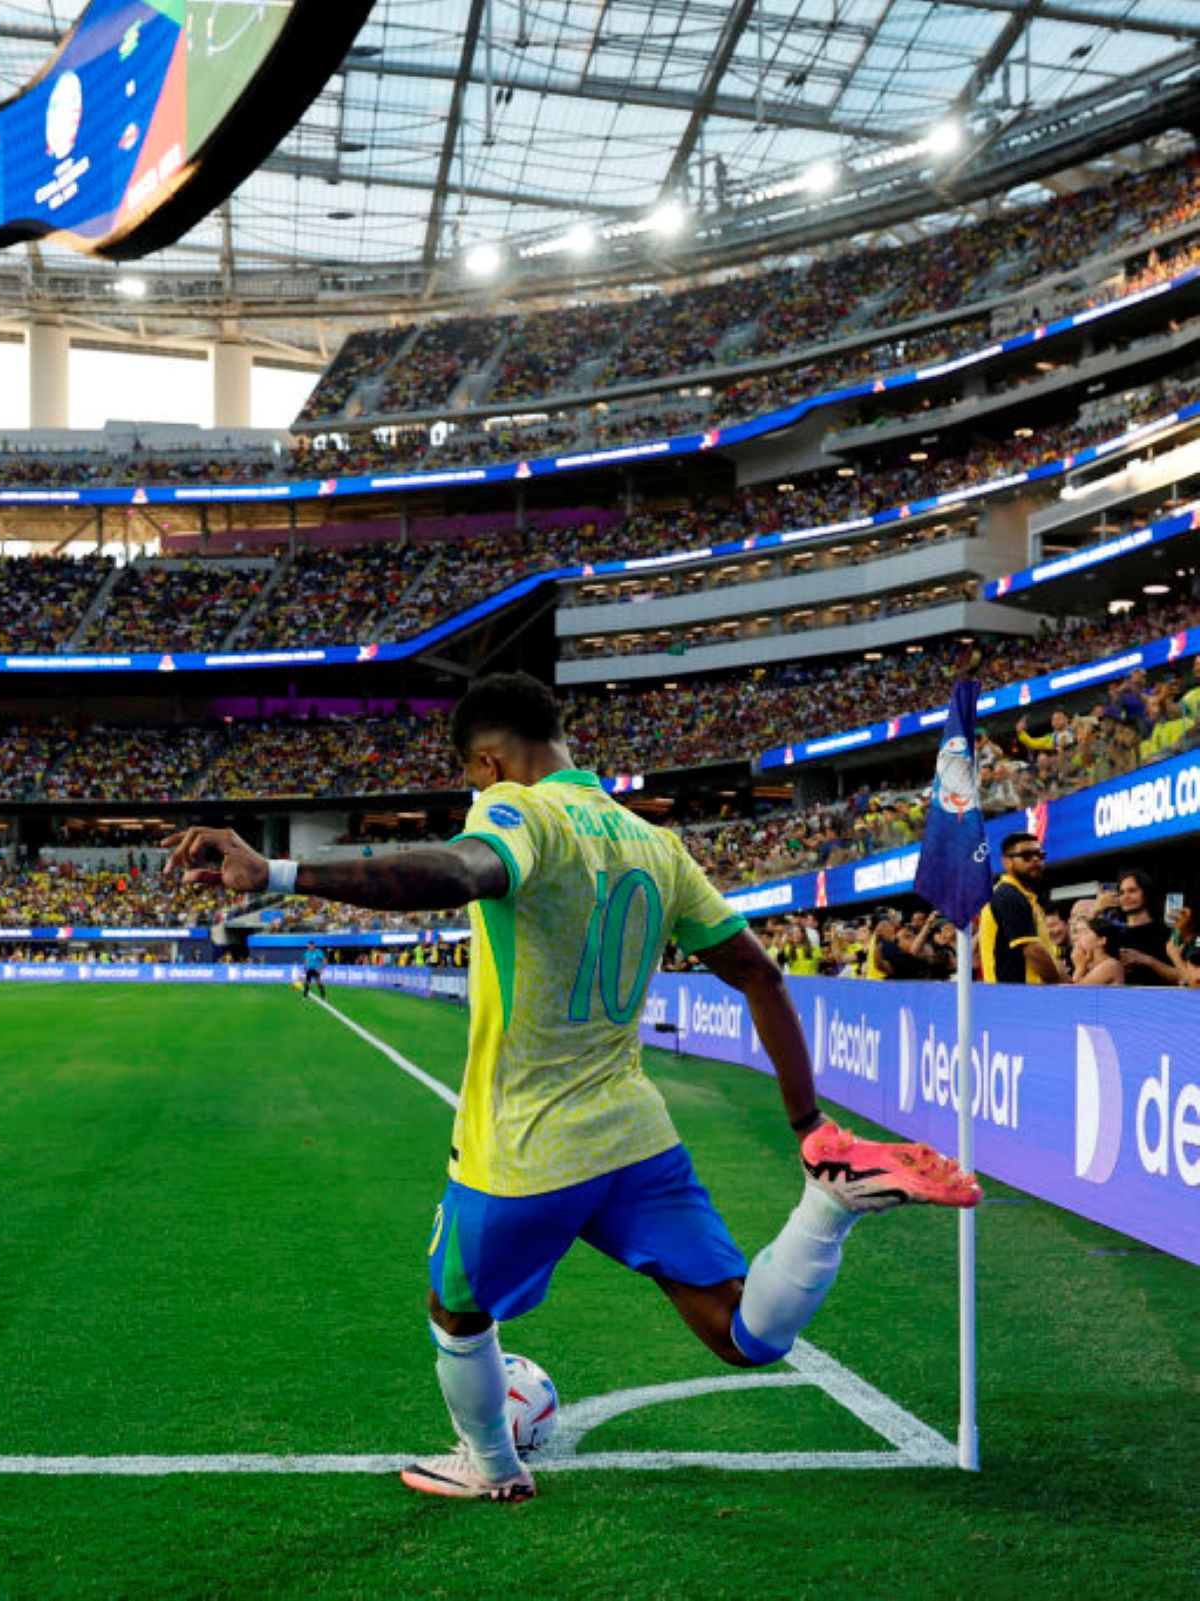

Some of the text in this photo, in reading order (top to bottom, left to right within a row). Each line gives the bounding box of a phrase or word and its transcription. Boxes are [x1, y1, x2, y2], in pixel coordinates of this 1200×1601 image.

[1094, 774, 1174, 838] CONMEBOL
[568, 868, 663, 1025] 10
[692, 992, 743, 1039] decolar
[828, 1008, 882, 1083] decolar
